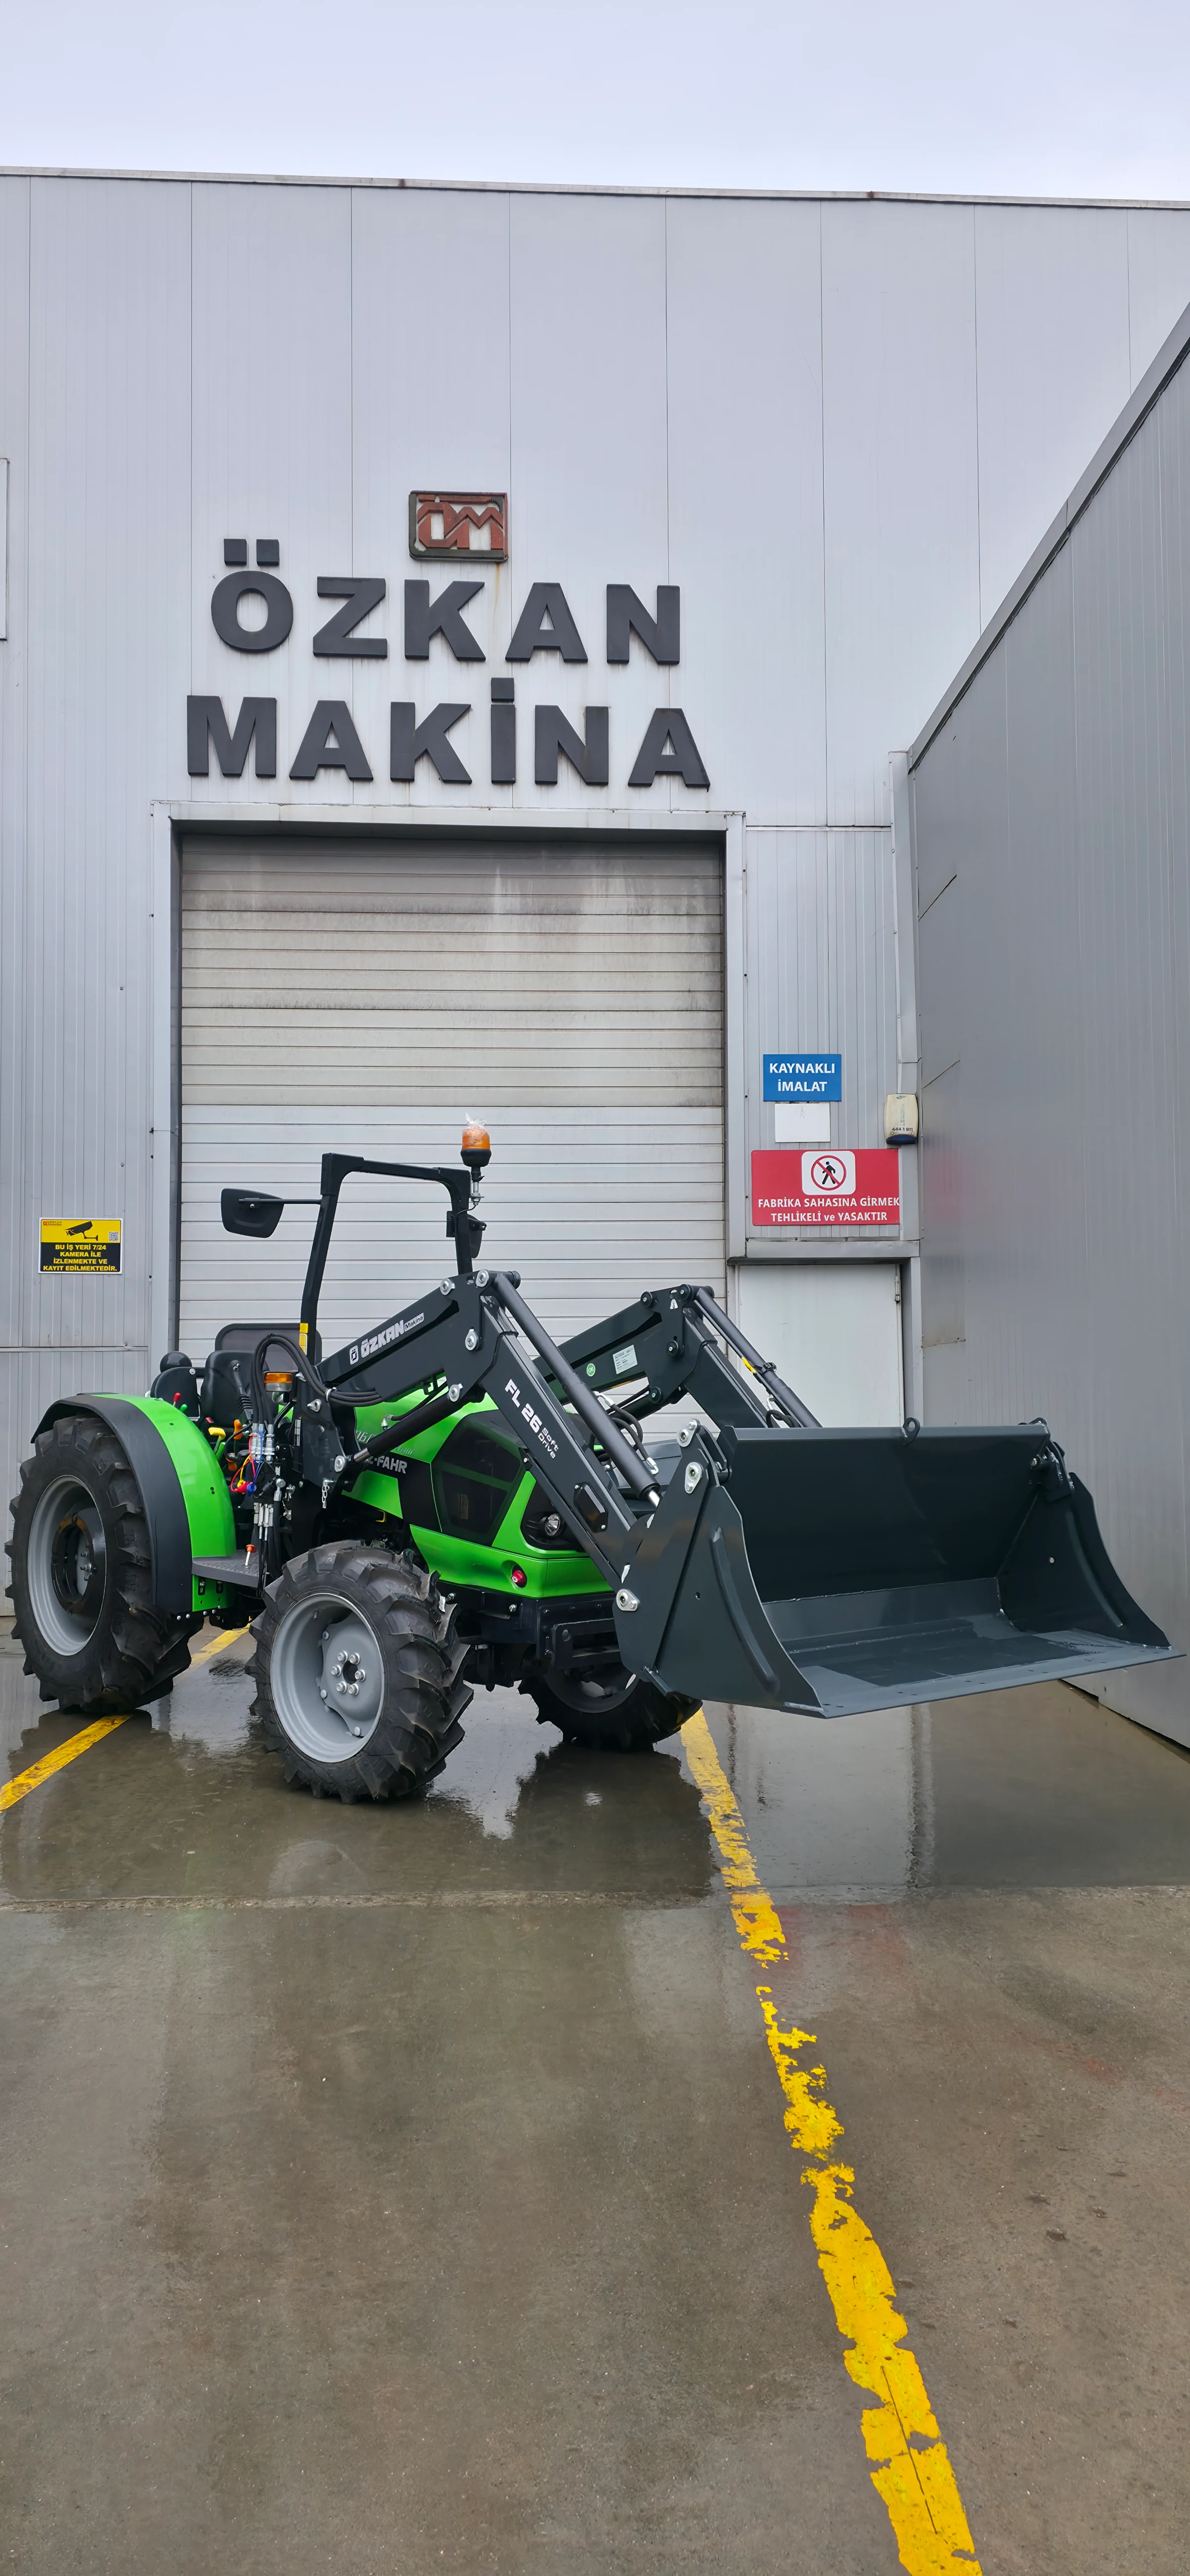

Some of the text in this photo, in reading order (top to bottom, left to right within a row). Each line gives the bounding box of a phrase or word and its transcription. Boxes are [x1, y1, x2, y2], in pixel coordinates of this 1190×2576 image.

[211, 538, 680, 665] ÖZKAN
[186, 677, 711, 789] MAKİNA
[770, 1063, 835, 1073] KAYNAKLI
[778, 1079, 828, 1091] İMALAT
[758, 1196, 900, 1207] FABRİKA SAHASINA GİRMEK
[771, 1211, 821, 1222] TEHLİKELİ
[838, 1212, 888, 1221] YASAKTIR
[361, 1319, 405, 1358] ÖZKAN
[405, 1316, 423, 1330] Makina
[504, 1378, 542, 1433] FL 26
[538, 1433, 556, 1459] Drive
[542, 1428, 559, 1452] Soft
